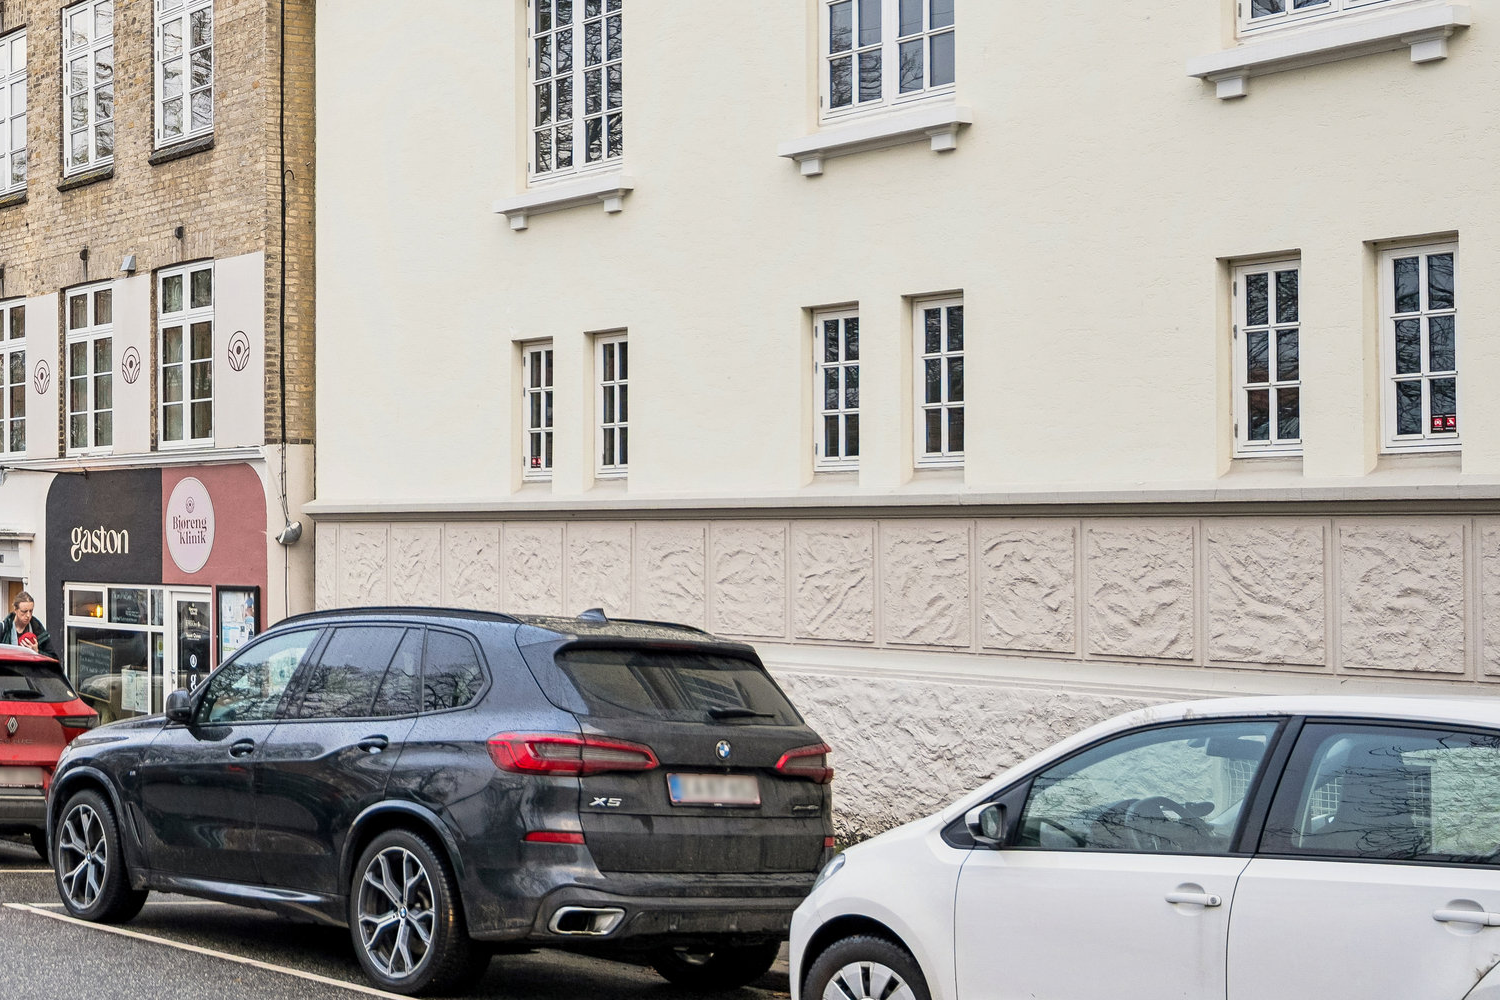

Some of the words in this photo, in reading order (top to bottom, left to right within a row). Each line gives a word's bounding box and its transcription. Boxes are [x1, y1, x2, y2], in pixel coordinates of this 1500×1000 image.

[172, 515, 207, 532] Bjøreng
[70, 525, 129, 562] gaston
[178, 530, 206, 545] Klinik
[589, 797, 622, 808] X5
